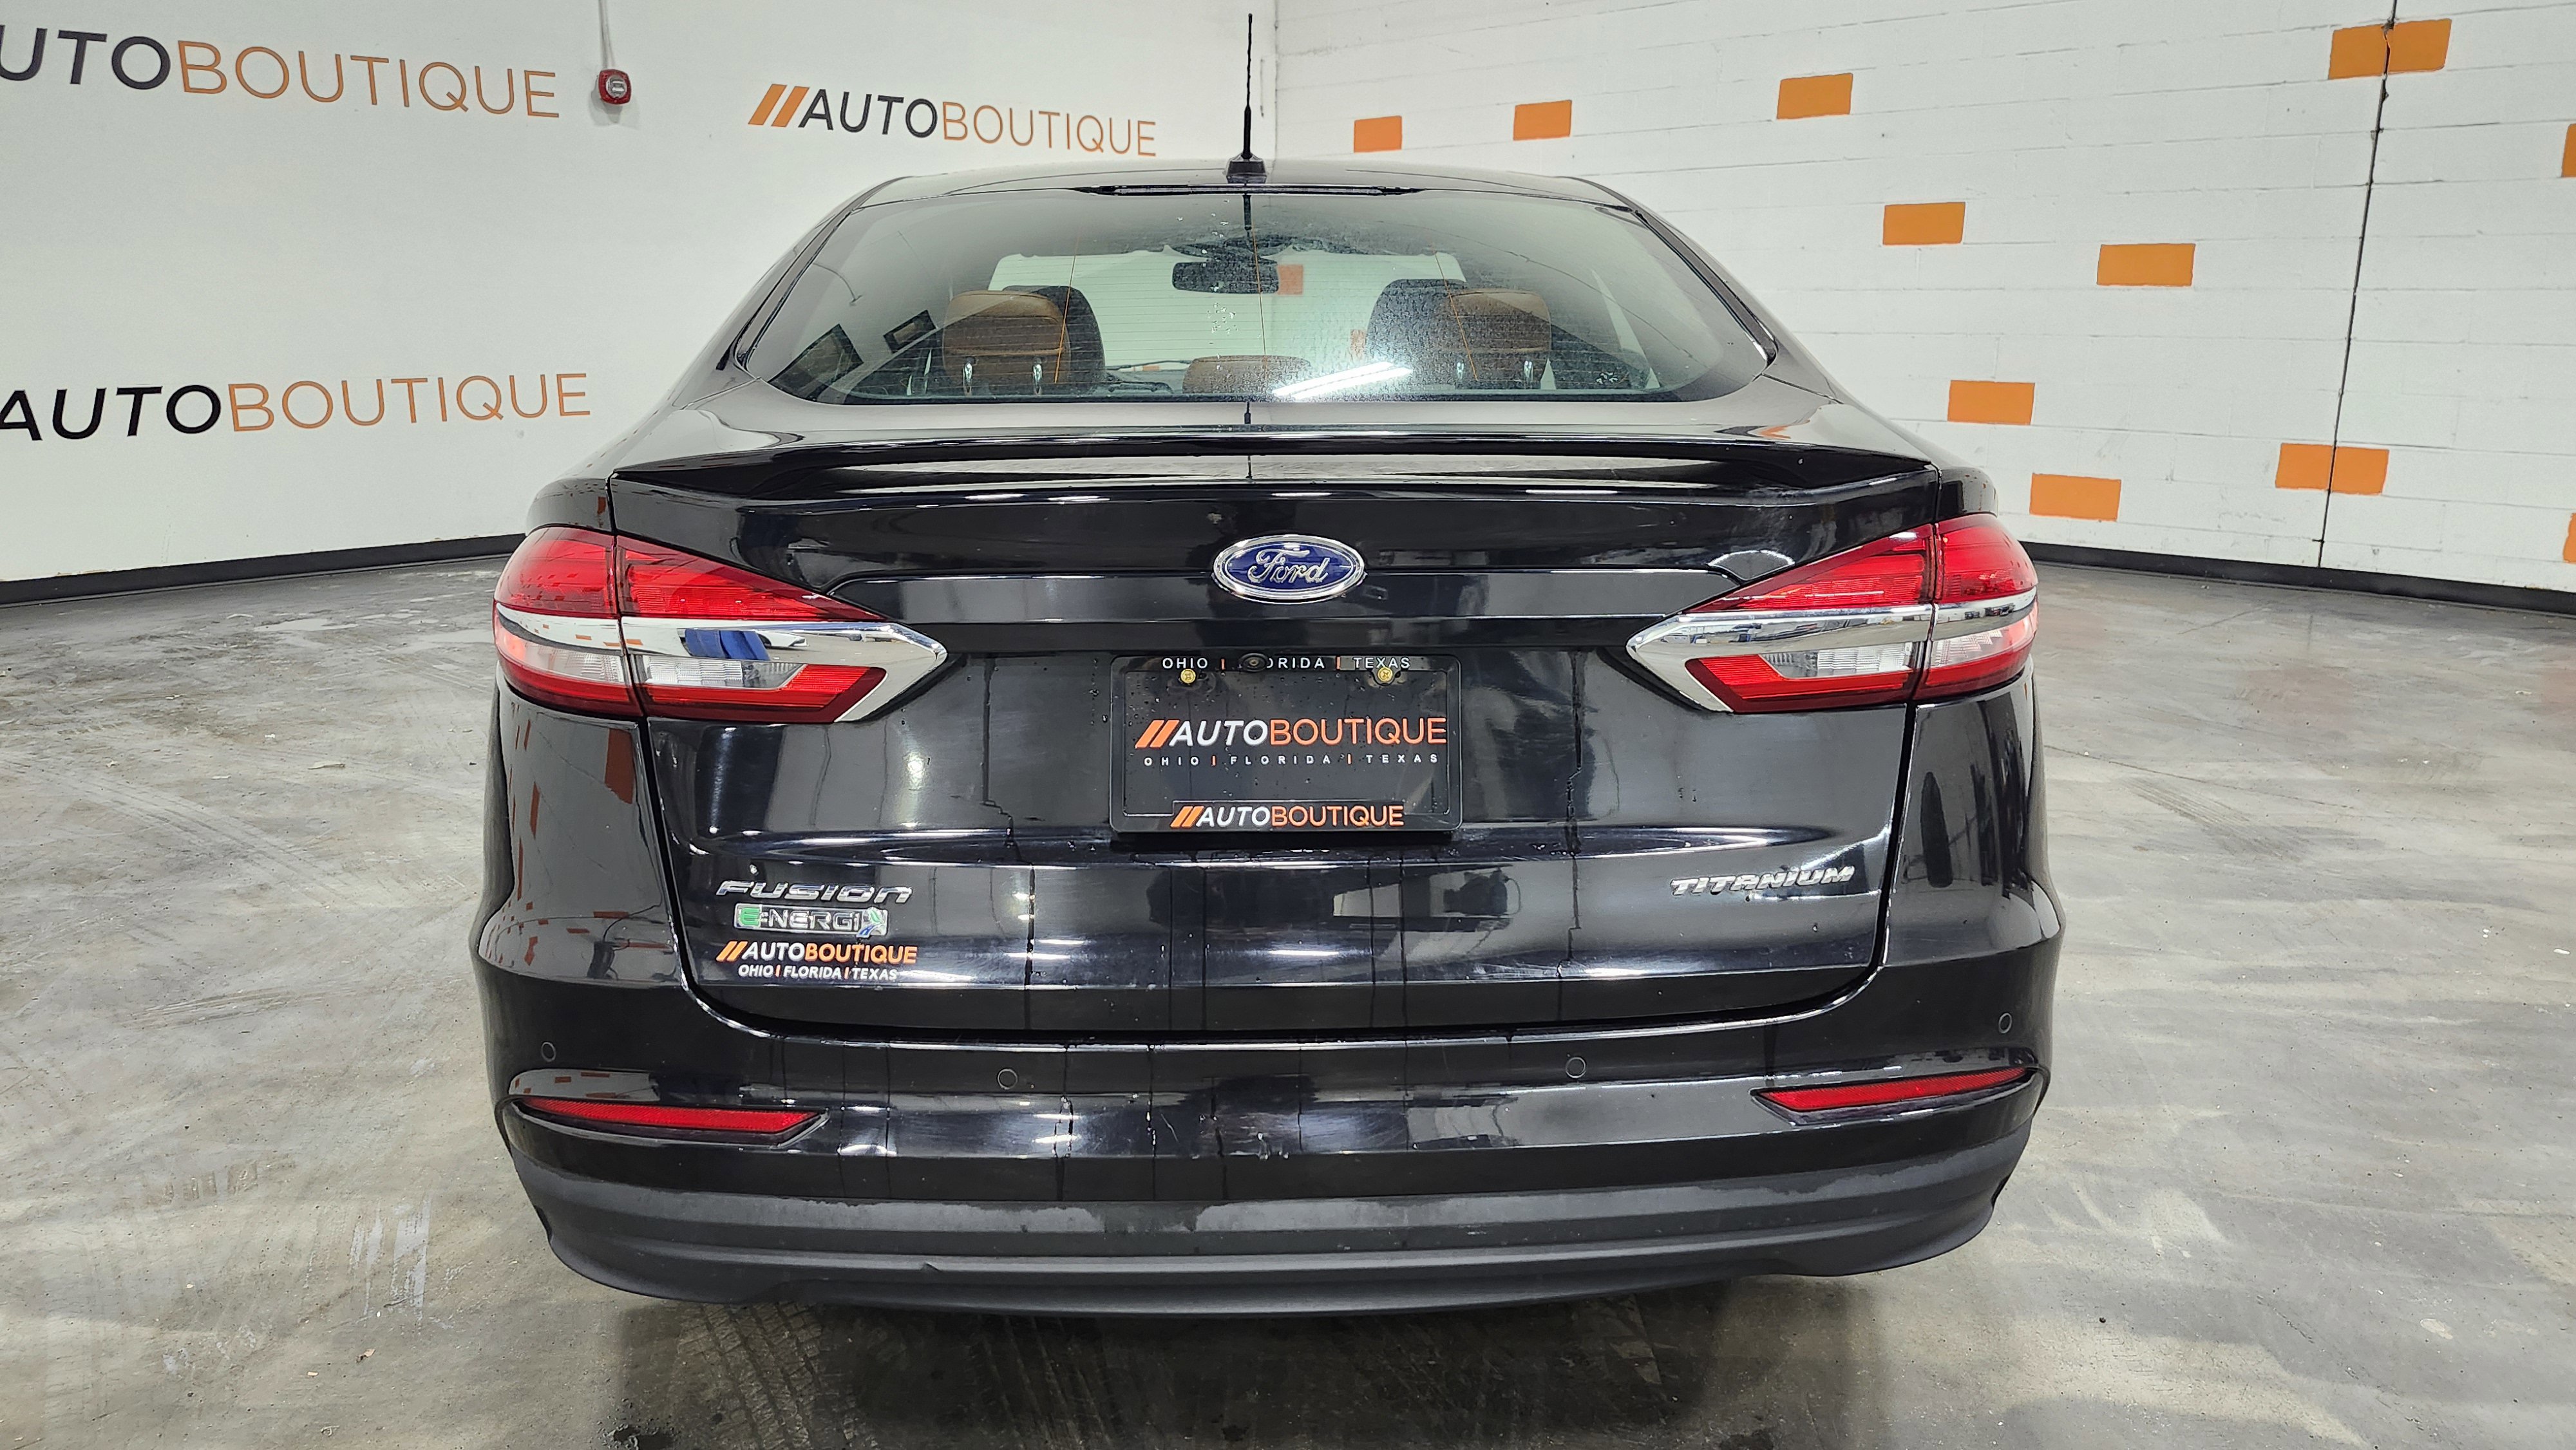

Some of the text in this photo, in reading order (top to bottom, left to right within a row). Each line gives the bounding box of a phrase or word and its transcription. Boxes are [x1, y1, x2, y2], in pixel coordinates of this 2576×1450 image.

[0, 24, 560, 118] UTOBOUTIQUE
[799, 88, 1157, 156] AUTOBOUTIQUE
[0, 373, 591, 441] AUTOBOUTIQUE
[1247, 549, 1331, 583] Ford
[1162, 656, 1410, 669] OHIO RIDA TEXAS
[1169, 717, 1447, 747] AUTOBOUTIQUE
[1144, 753, 1438, 766] OHIO FLORIDA TEXAS
[1196, 805, 1404, 827] AUTOBOUTIQUE
[715, 880, 913, 903] FUSION
[1671, 866, 1855, 895] TITANIUM
[742, 942, 918, 964] AUTOBOUTIQUE
[738, 965, 898, 981] OHIO FLORIDA TEXAS
